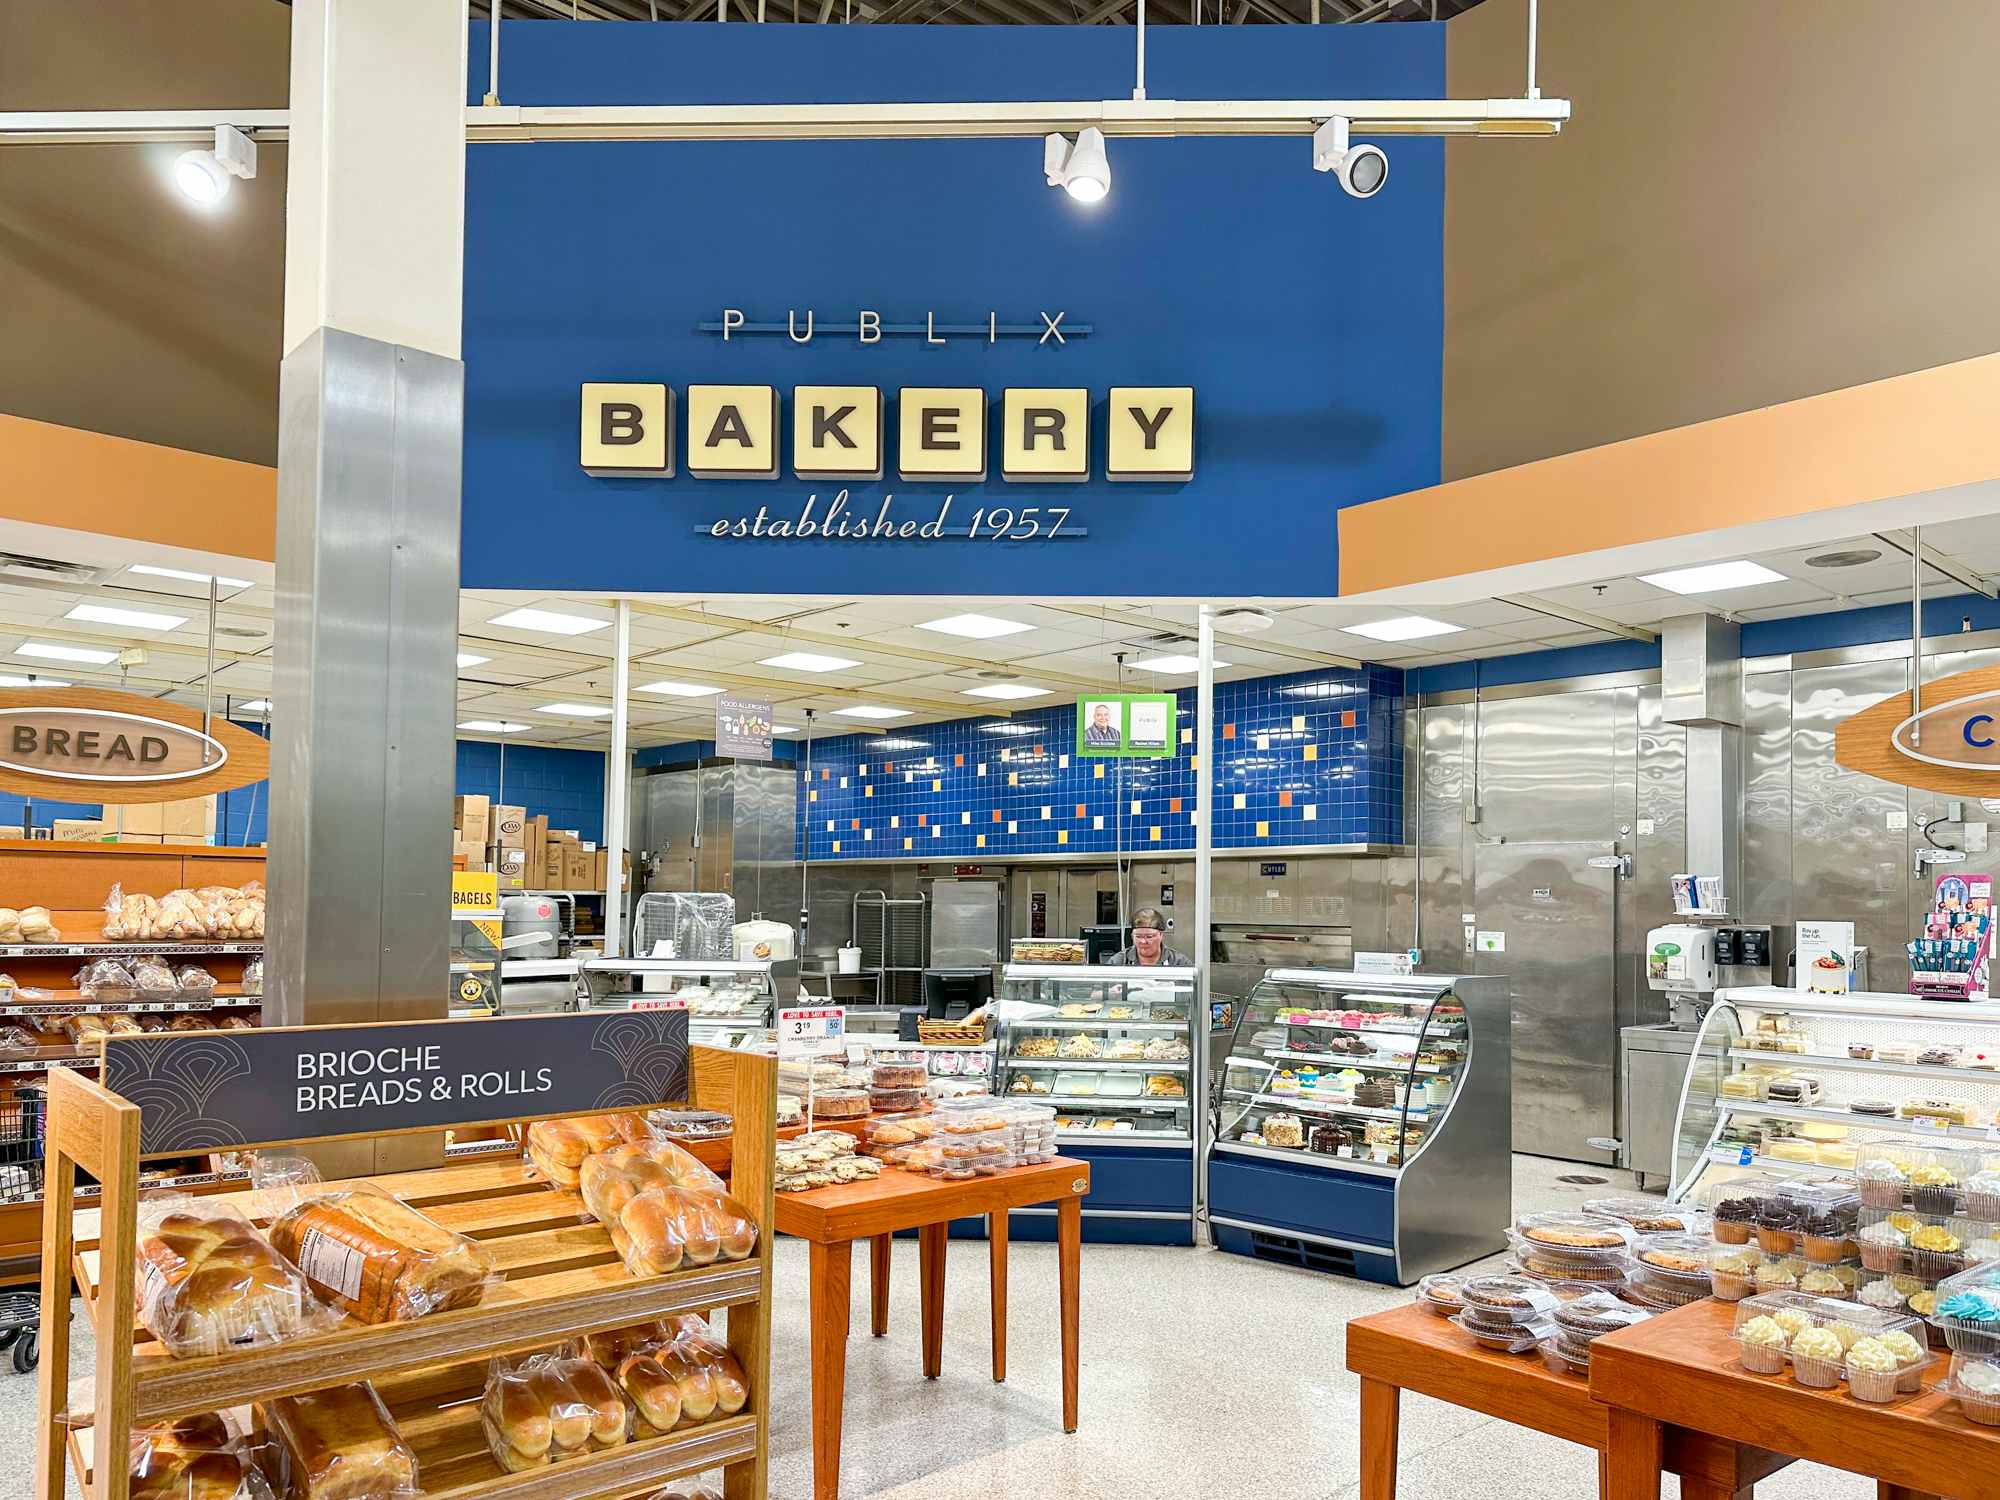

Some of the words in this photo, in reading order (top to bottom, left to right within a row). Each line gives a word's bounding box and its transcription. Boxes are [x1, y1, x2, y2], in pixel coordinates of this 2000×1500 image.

[722, 309, 1066, 345] PUBLIX
[600, 402, 1173, 451] BAKERY
[709, 488, 954, 541] established
[966, 506, 1071, 541] 1957
[12, 725, 170, 763] BREAD
[453, 891, 492, 905] BAGELS
[479, 921, 499, 942] NEW
[297, 1046, 441, 1079] BRIOCHE
[296, 1077, 424, 1112] BREADS
[429, 1076, 454, 1101] &
[460, 1067, 553, 1099] ROLLS
